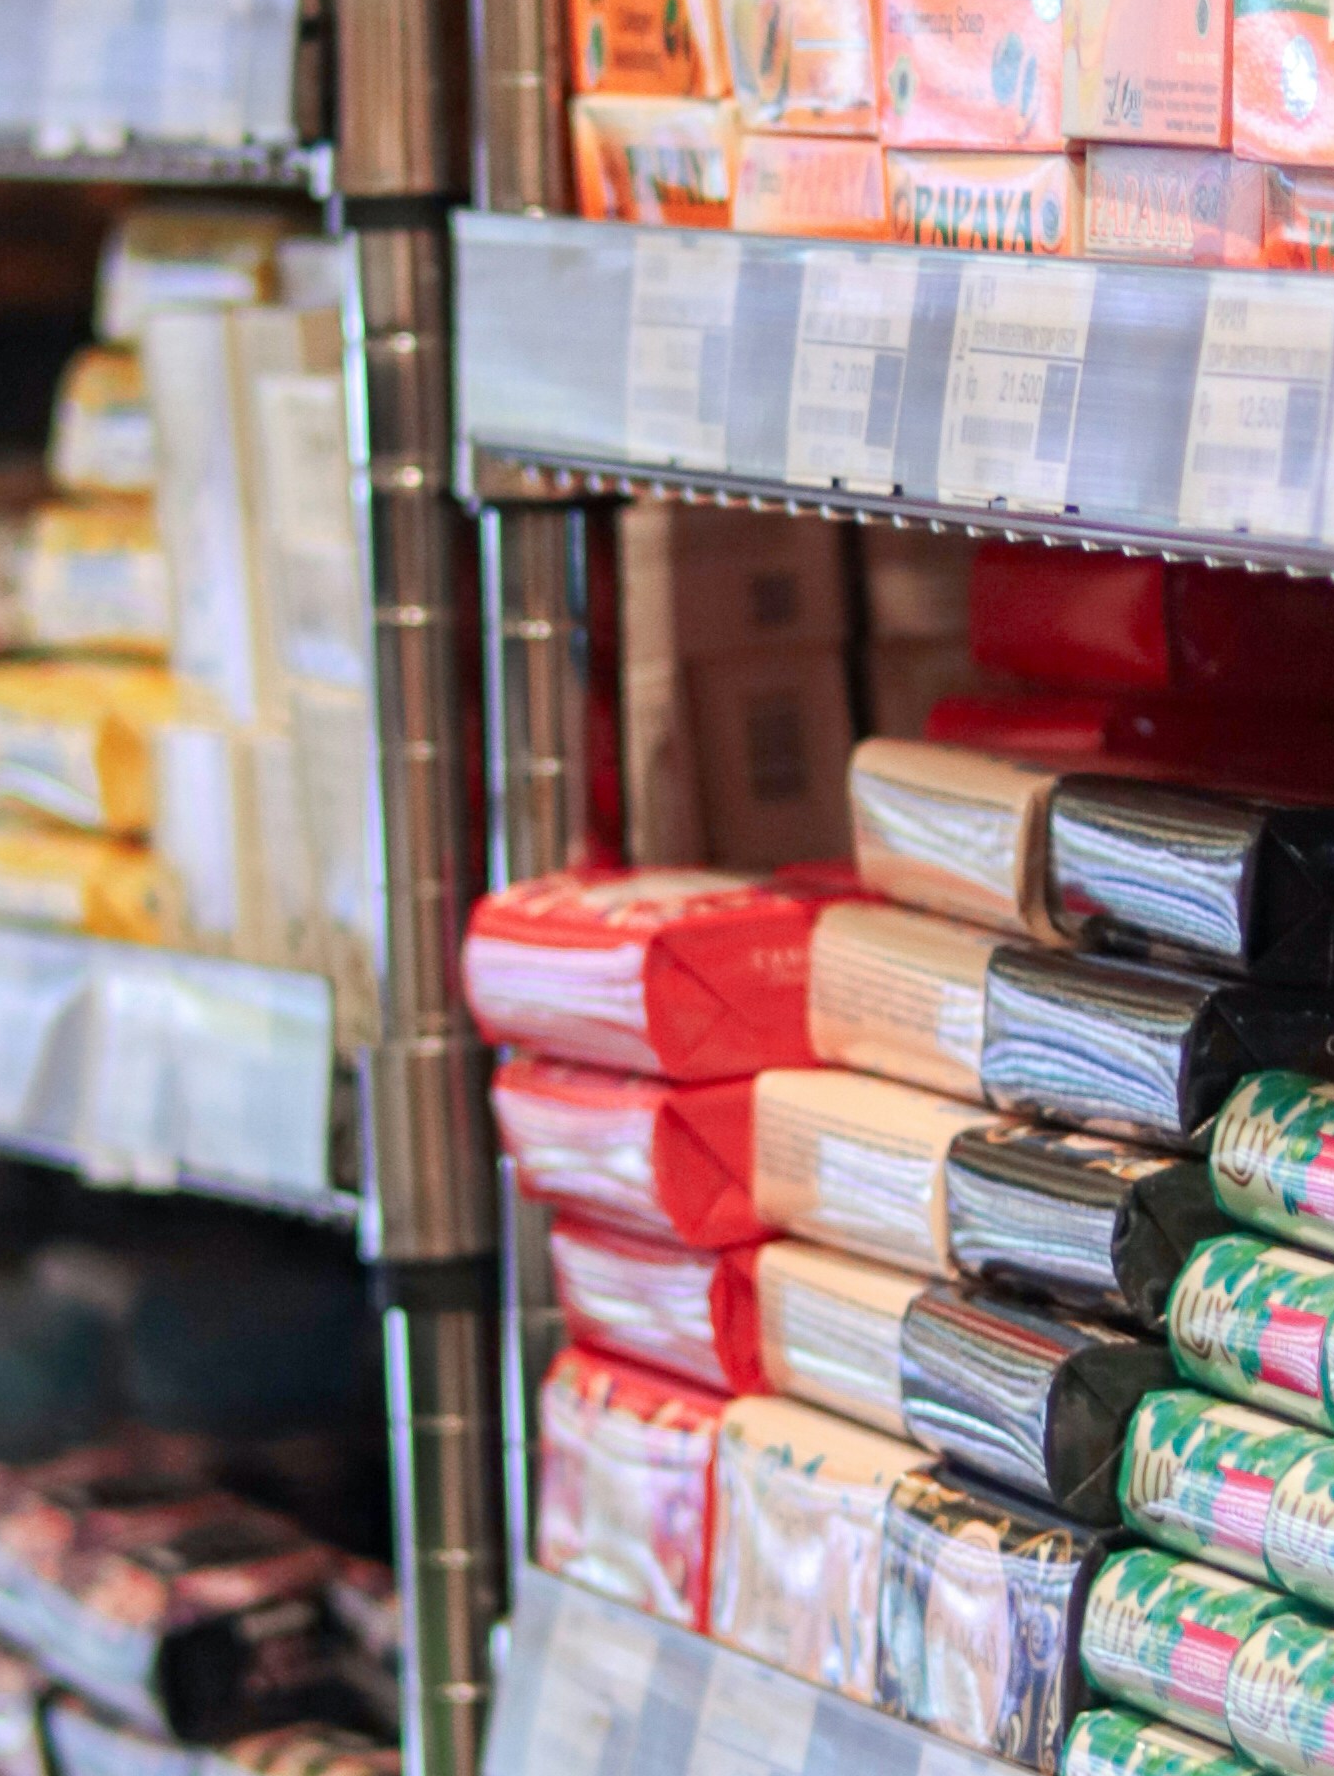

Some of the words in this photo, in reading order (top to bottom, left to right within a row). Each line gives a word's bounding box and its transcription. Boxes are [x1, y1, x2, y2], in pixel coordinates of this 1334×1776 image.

[916, 184, 1033, 252] PAPAYA
[1218, 1112, 1285, 1194] LUX
[1175, 1285, 1235, 1365] LUX
